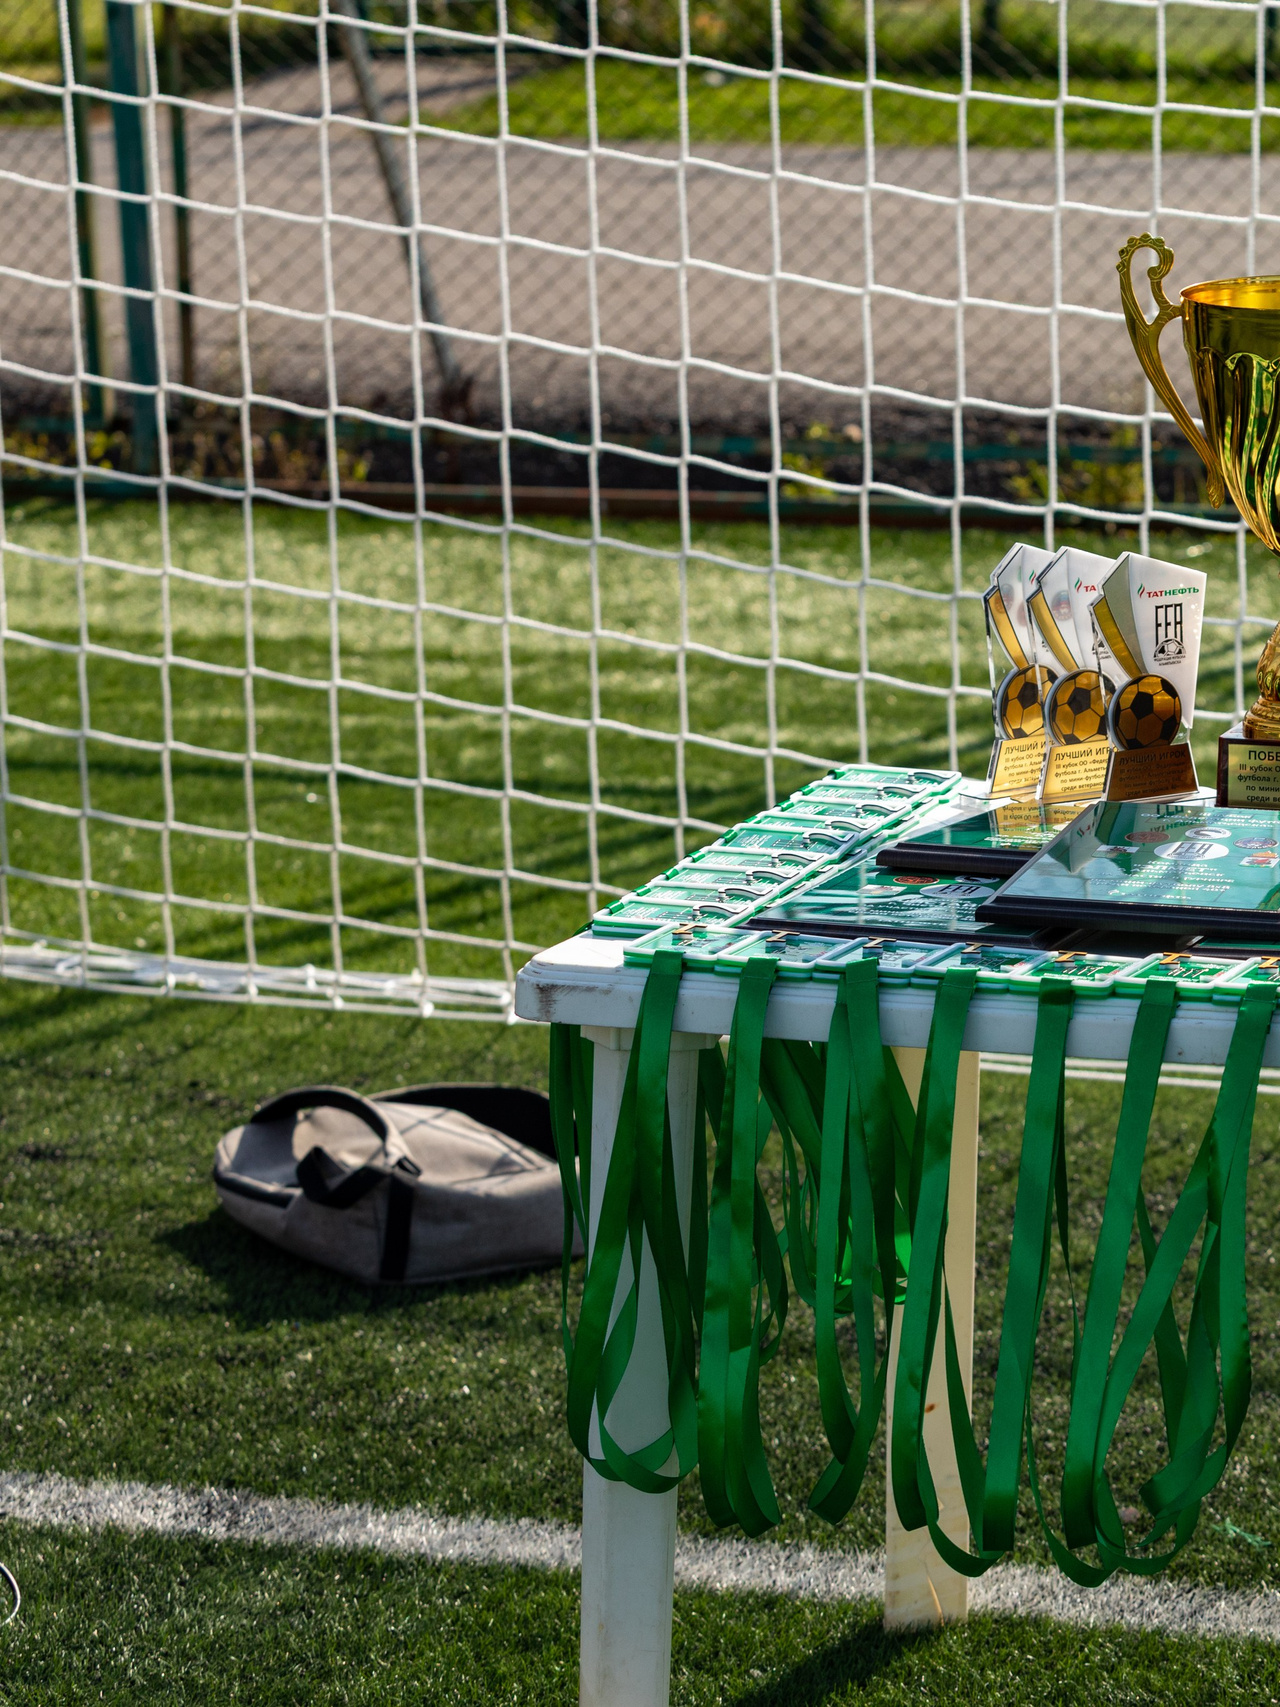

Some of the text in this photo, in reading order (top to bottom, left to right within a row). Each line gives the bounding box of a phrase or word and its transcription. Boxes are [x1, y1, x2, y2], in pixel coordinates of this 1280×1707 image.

[1146, 586, 1200, 599] ТАТНЕФТЬ
[1004, 741, 1039, 755] ЛУЧШИЙ
[1054, 748, 1093, 761] ЛУЧШИЙ
[1119, 750, 1186, 766] ЛУЧШИЙ ИГРОК
[1054, 770, 1077, 778] футбола
[1249, 764, 1273, 774] кубок
[1069, 774, 1105, 783] мини-футбол
[1237, 773, 1271, 783] футбола
[1078, 781, 1104, 790] ветерано
[1246, 795, 1270, 803] среди
